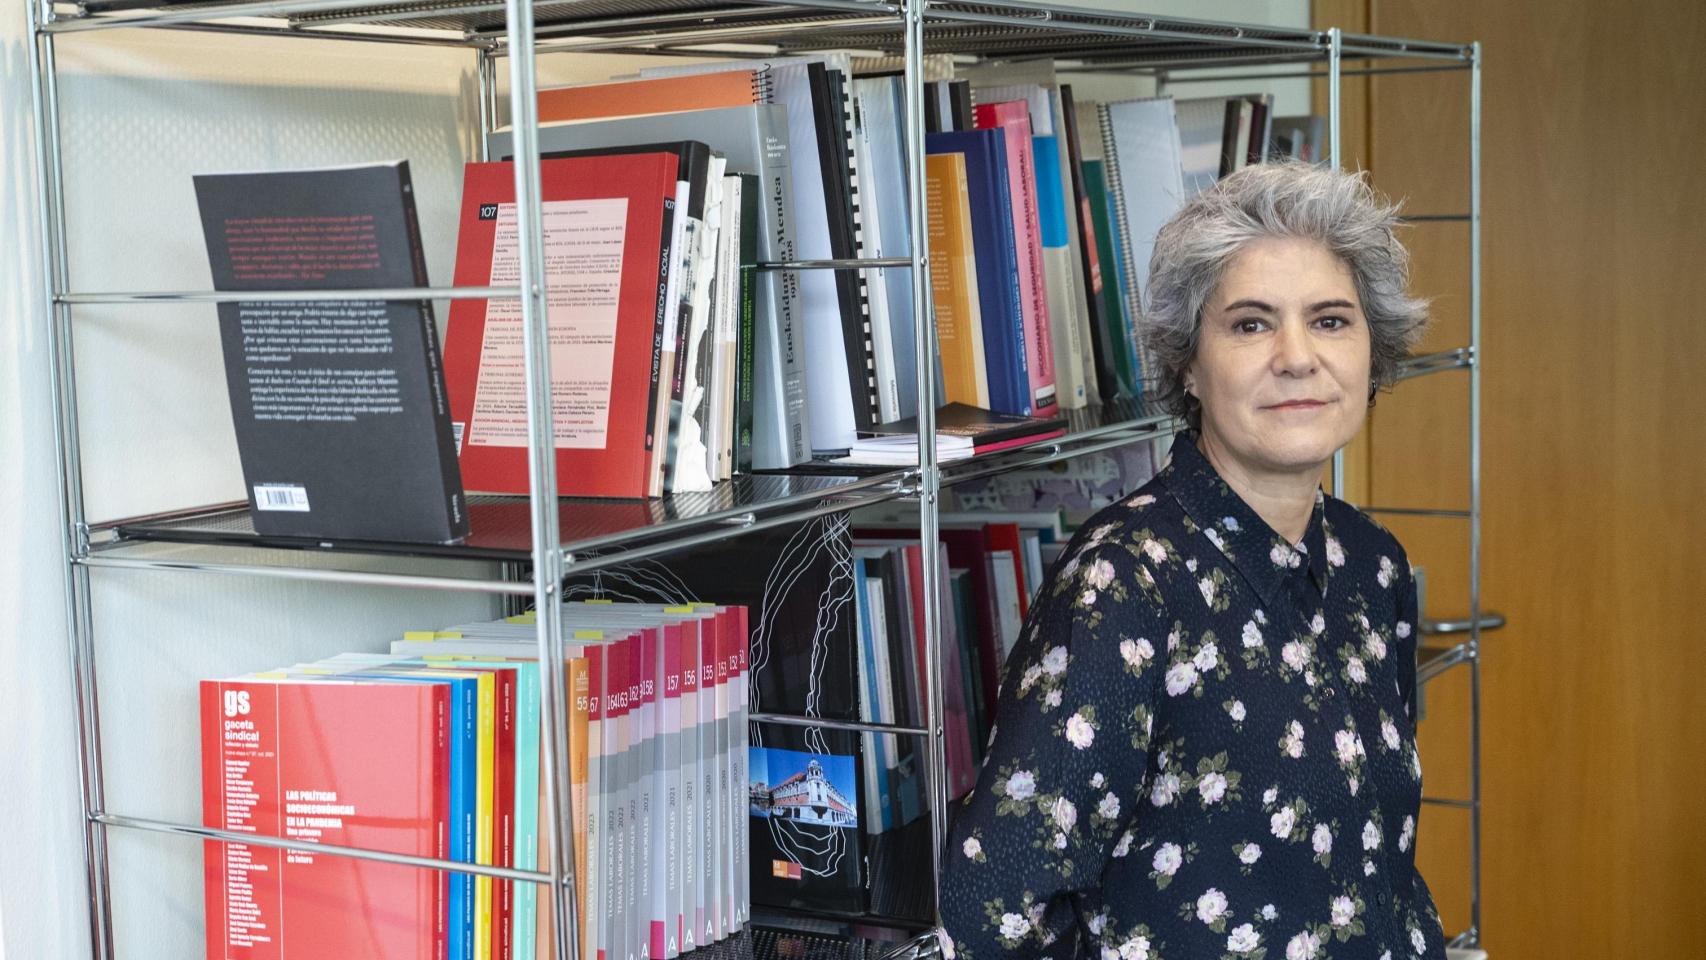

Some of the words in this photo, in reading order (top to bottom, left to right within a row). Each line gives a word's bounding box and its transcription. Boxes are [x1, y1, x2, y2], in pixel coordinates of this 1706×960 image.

[481, 207, 497, 218] 107
[774, 176, 785, 244] Mendea
[1028, 242, 1037, 297] SEGURIDAD
[1033, 299, 1038, 311] DE
[655, 333, 662, 347] DE
[718, 661, 727, 677] 153
[729, 655, 738, 670] 152
[684, 670, 696, 686] 156
[703, 665, 714, 680] 155
[642, 680, 654, 696] 158
[667, 674, 679, 691] 157
[617, 691, 628, 708] 163
[629, 685, 639, 701] 162
[224, 690, 251, 718] gs
[577, 696, 588, 711] 55
[588, 696, 599, 713] 67
[607, 694, 618, 711] 164
[224, 720, 254, 731] gaceta
[224, 730, 260, 742] sindical
[286, 790, 299, 801] LAS
[300, 790, 337, 802] POLÍTICAS
[286, 803, 355, 815] SOCIOECONÓMICAS
[286, 816, 296, 826] EN
[296, 817, 305, 827] LA
[305, 818, 342, 829] PANDEMIA
